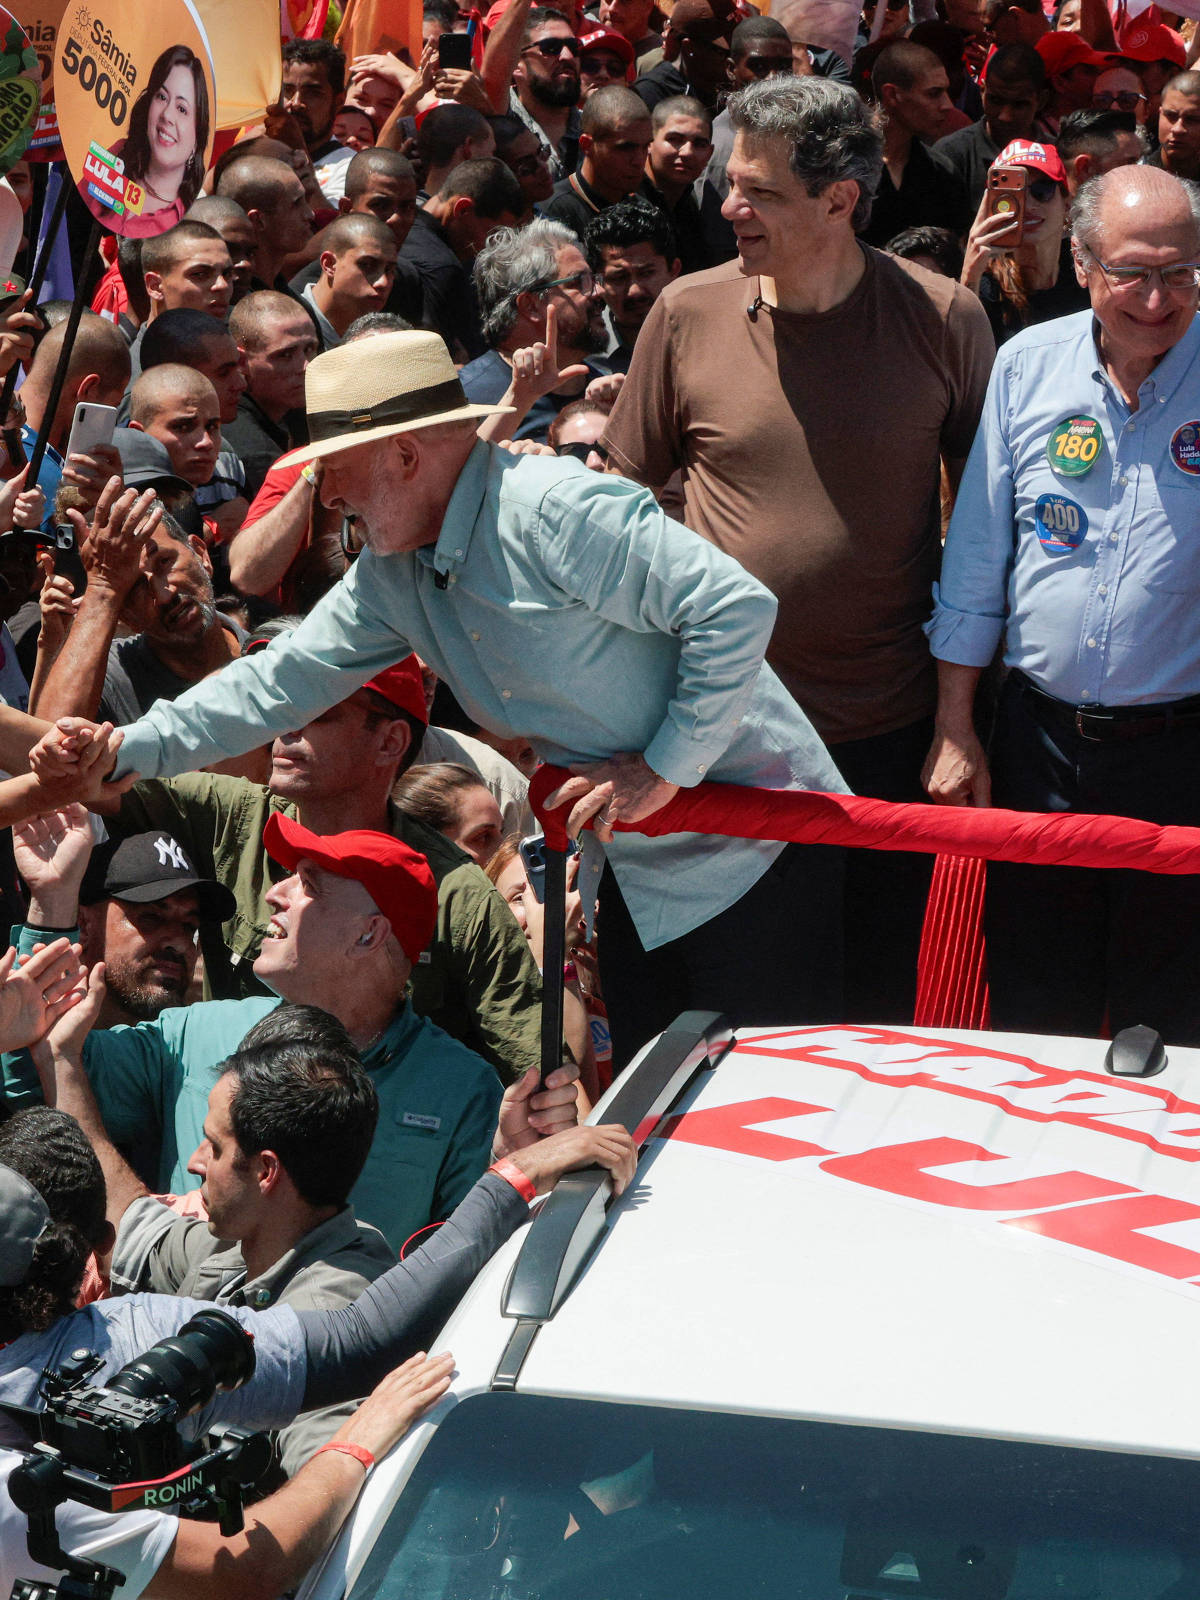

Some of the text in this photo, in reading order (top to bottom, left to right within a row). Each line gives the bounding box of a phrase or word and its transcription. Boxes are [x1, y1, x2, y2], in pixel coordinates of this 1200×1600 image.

[91, 19, 137, 86] Sâmia
[62, 37, 127, 126] 5000
[85, 155, 124, 194] LULA
[126, 183, 141, 205] 13
[1055, 433, 1098, 462] 180
[1042, 503, 1080, 532] 400
[144, 1470, 203, 1506] RONIN
